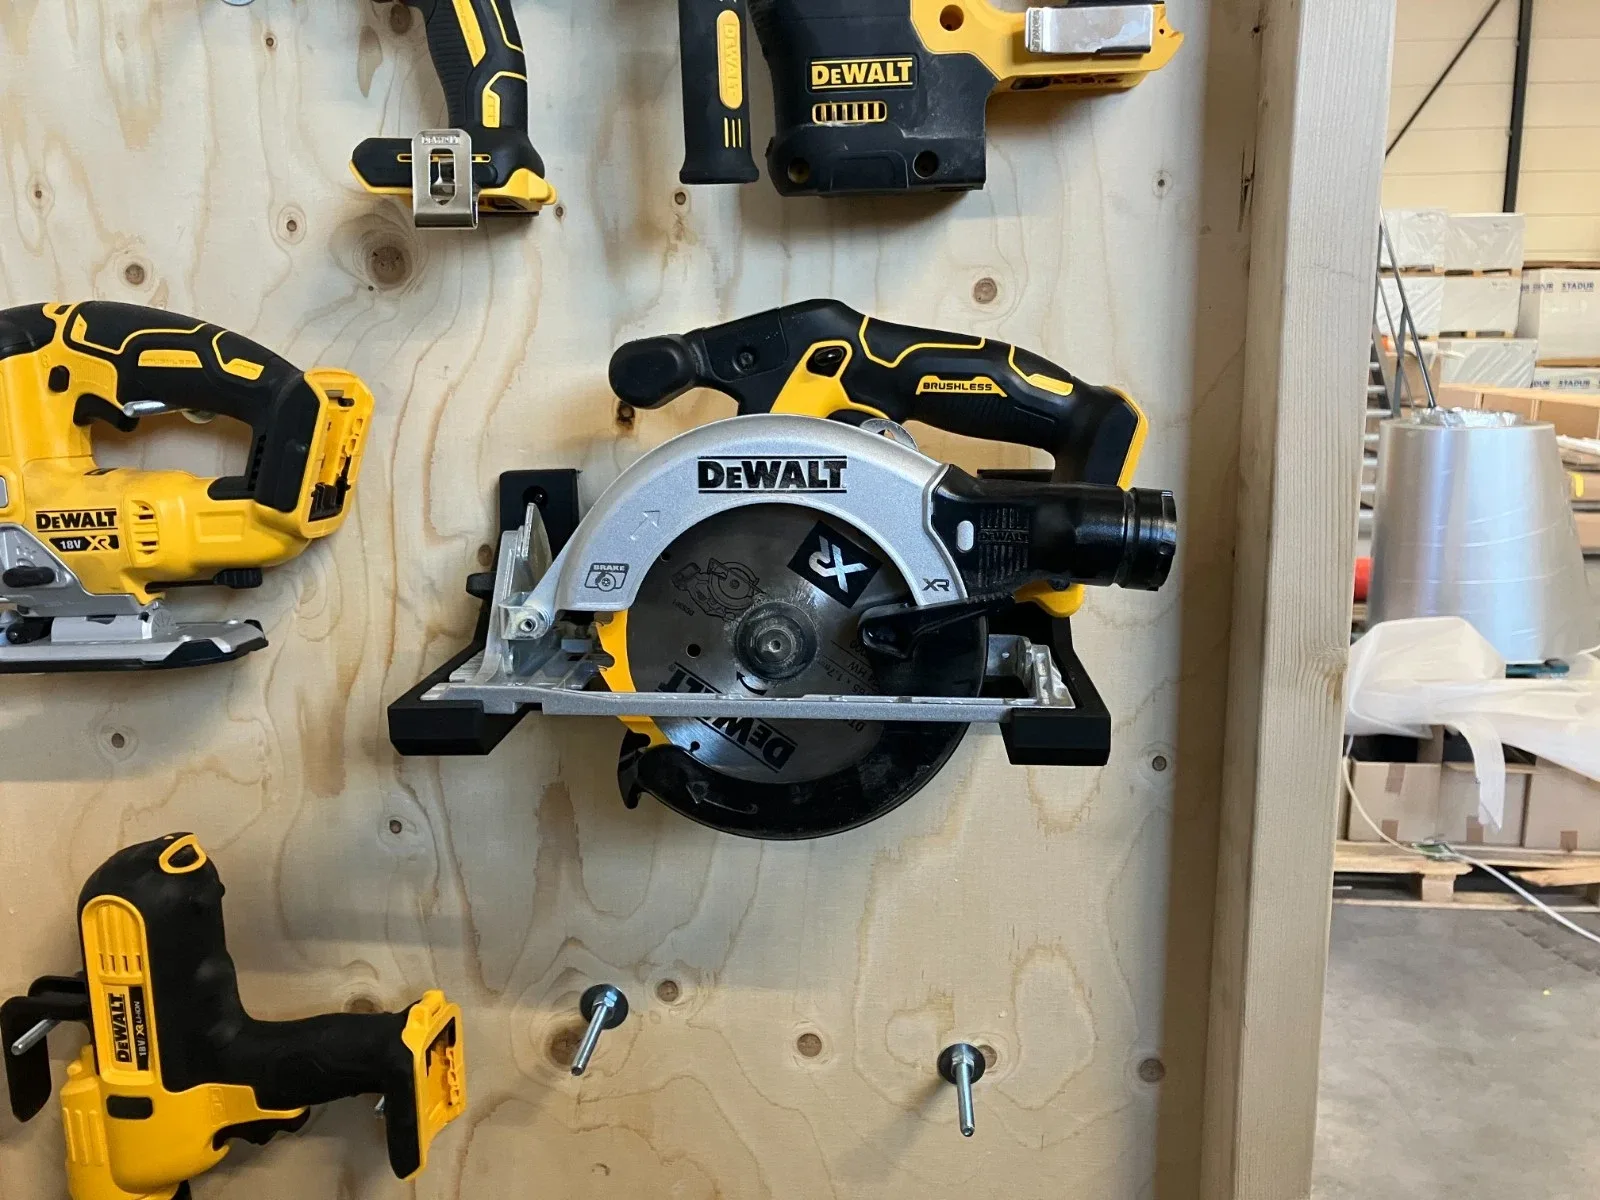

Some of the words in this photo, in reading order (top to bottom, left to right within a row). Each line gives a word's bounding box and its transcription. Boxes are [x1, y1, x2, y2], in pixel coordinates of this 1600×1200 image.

[811, 62, 912, 86] DEWALT
[923, 382, 993, 392] BRUSHLESS
[698, 460, 847, 489] DEWALT
[36, 511, 117, 529] DEWALT
[60, 540, 81, 550] 18V
[84, 535, 111, 551] XR
[808, 535, 869, 594] XR
[921, 578, 950, 592] XR
[656, 668, 796, 770] DEWLT
[109, 993, 131, 1062] DEWALT
